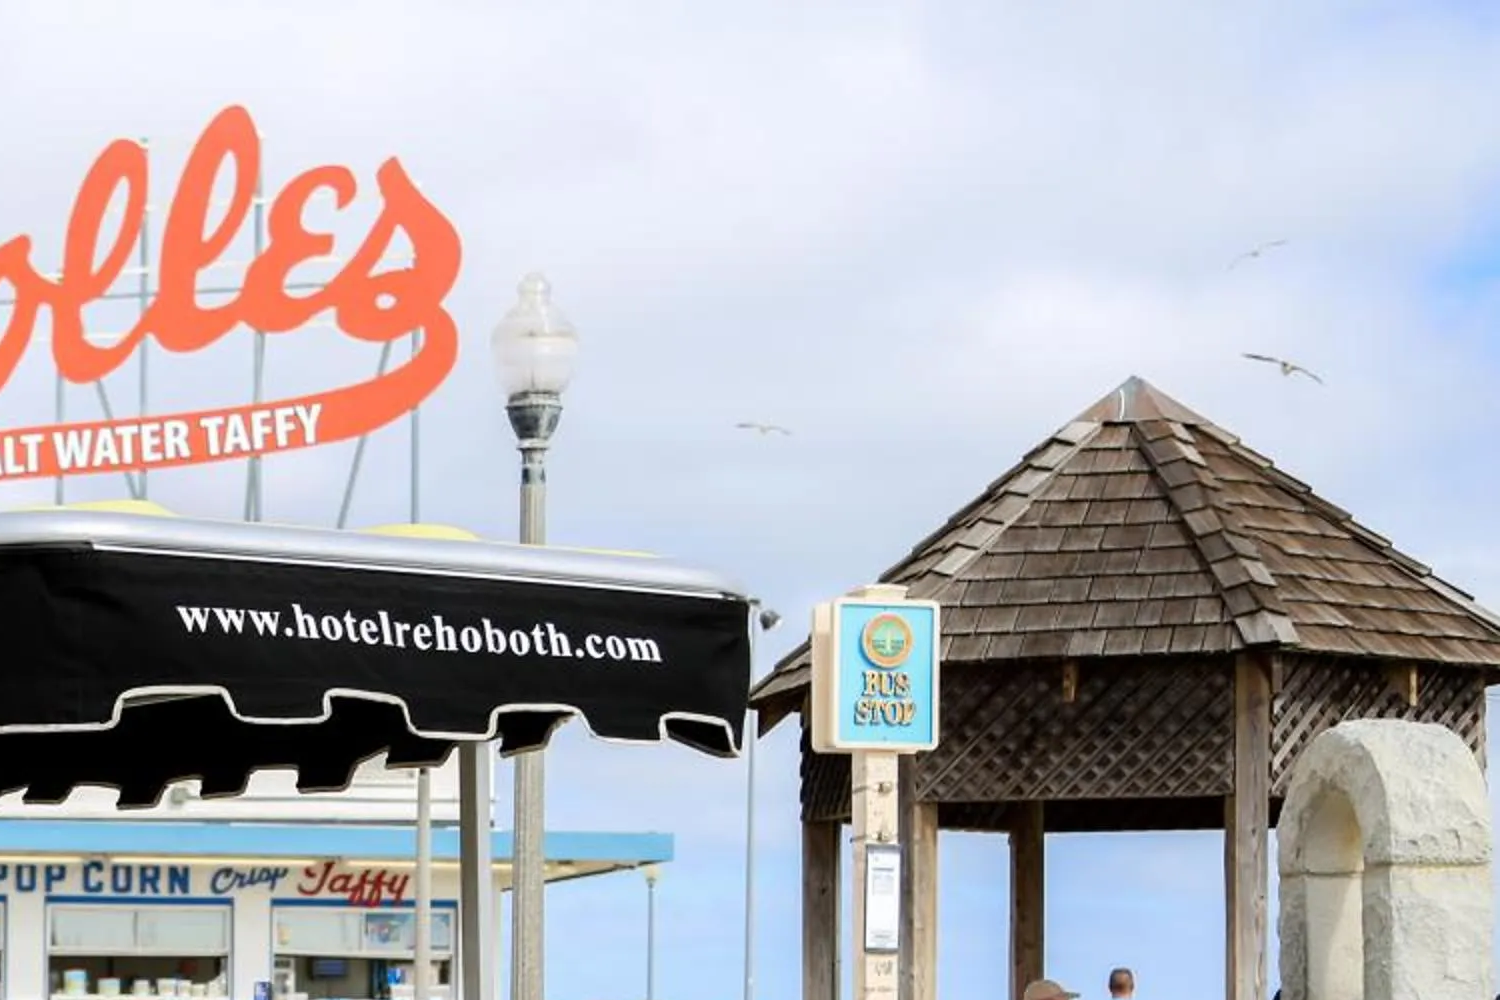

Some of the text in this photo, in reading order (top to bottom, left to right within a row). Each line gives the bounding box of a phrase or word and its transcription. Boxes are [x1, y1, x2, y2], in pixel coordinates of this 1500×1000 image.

[53, 419, 191, 470] WATER
[200, 403, 322, 458] TAFFY
[176, 603, 663, 663] www.hotelrehoboth.com
[861, 670, 910, 697] BUS
[854, 697, 916, 727] STOP
[83, 860, 190, 895] CORN
[297, 861, 410, 908] Taffy
